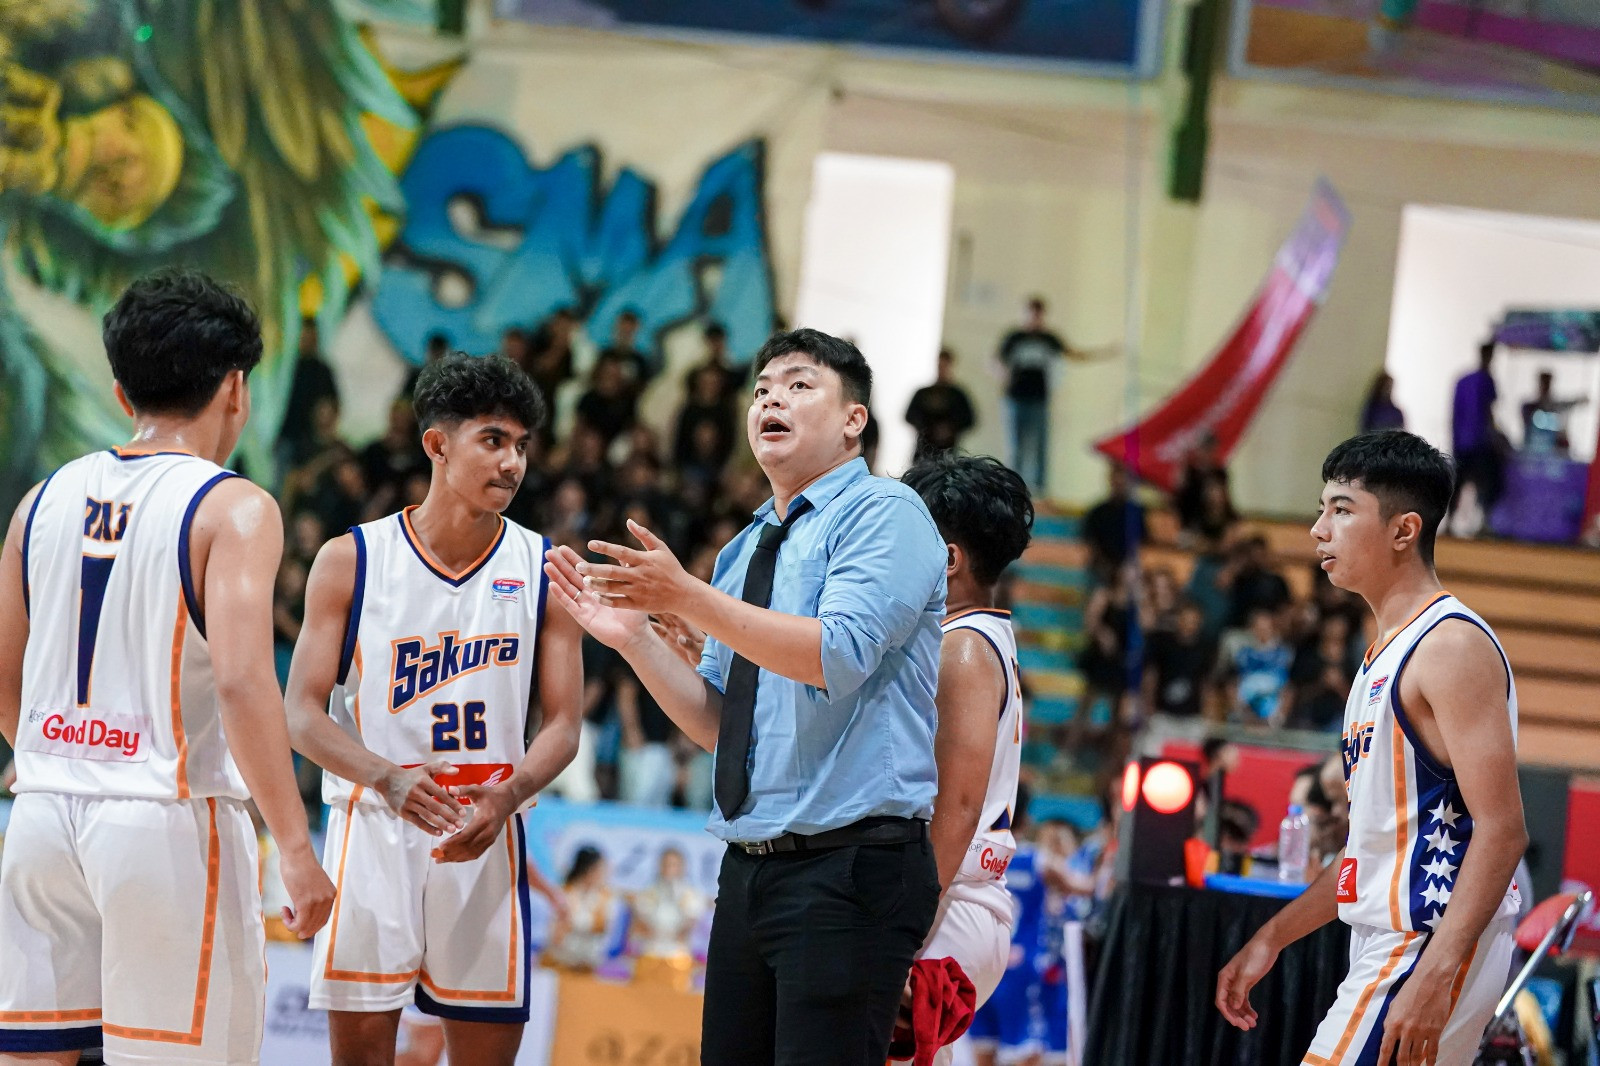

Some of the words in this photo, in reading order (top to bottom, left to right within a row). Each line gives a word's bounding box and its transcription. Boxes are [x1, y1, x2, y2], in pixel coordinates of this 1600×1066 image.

[372, 124, 776, 366] SMA
[388, 629, 520, 714] Sakura
[431, 700, 488, 752] 26
